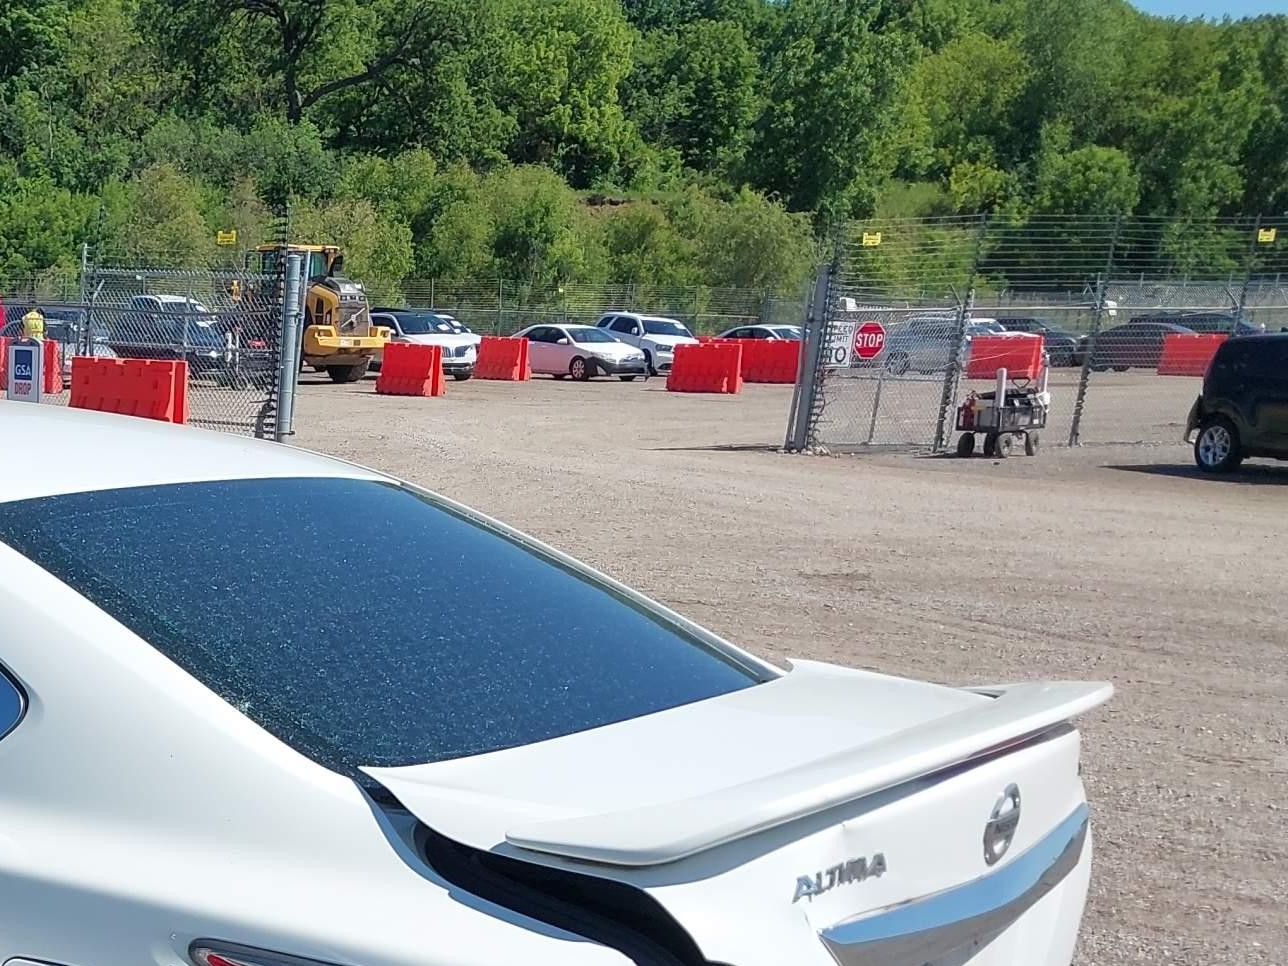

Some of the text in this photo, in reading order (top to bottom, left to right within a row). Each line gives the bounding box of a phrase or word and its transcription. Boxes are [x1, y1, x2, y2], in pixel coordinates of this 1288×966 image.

[855, 333, 883, 347] STOP
[15, 364, 32, 377] GSA
[14, 382, 32, 396] DROP
[792, 852, 887, 903] ALTIMA
